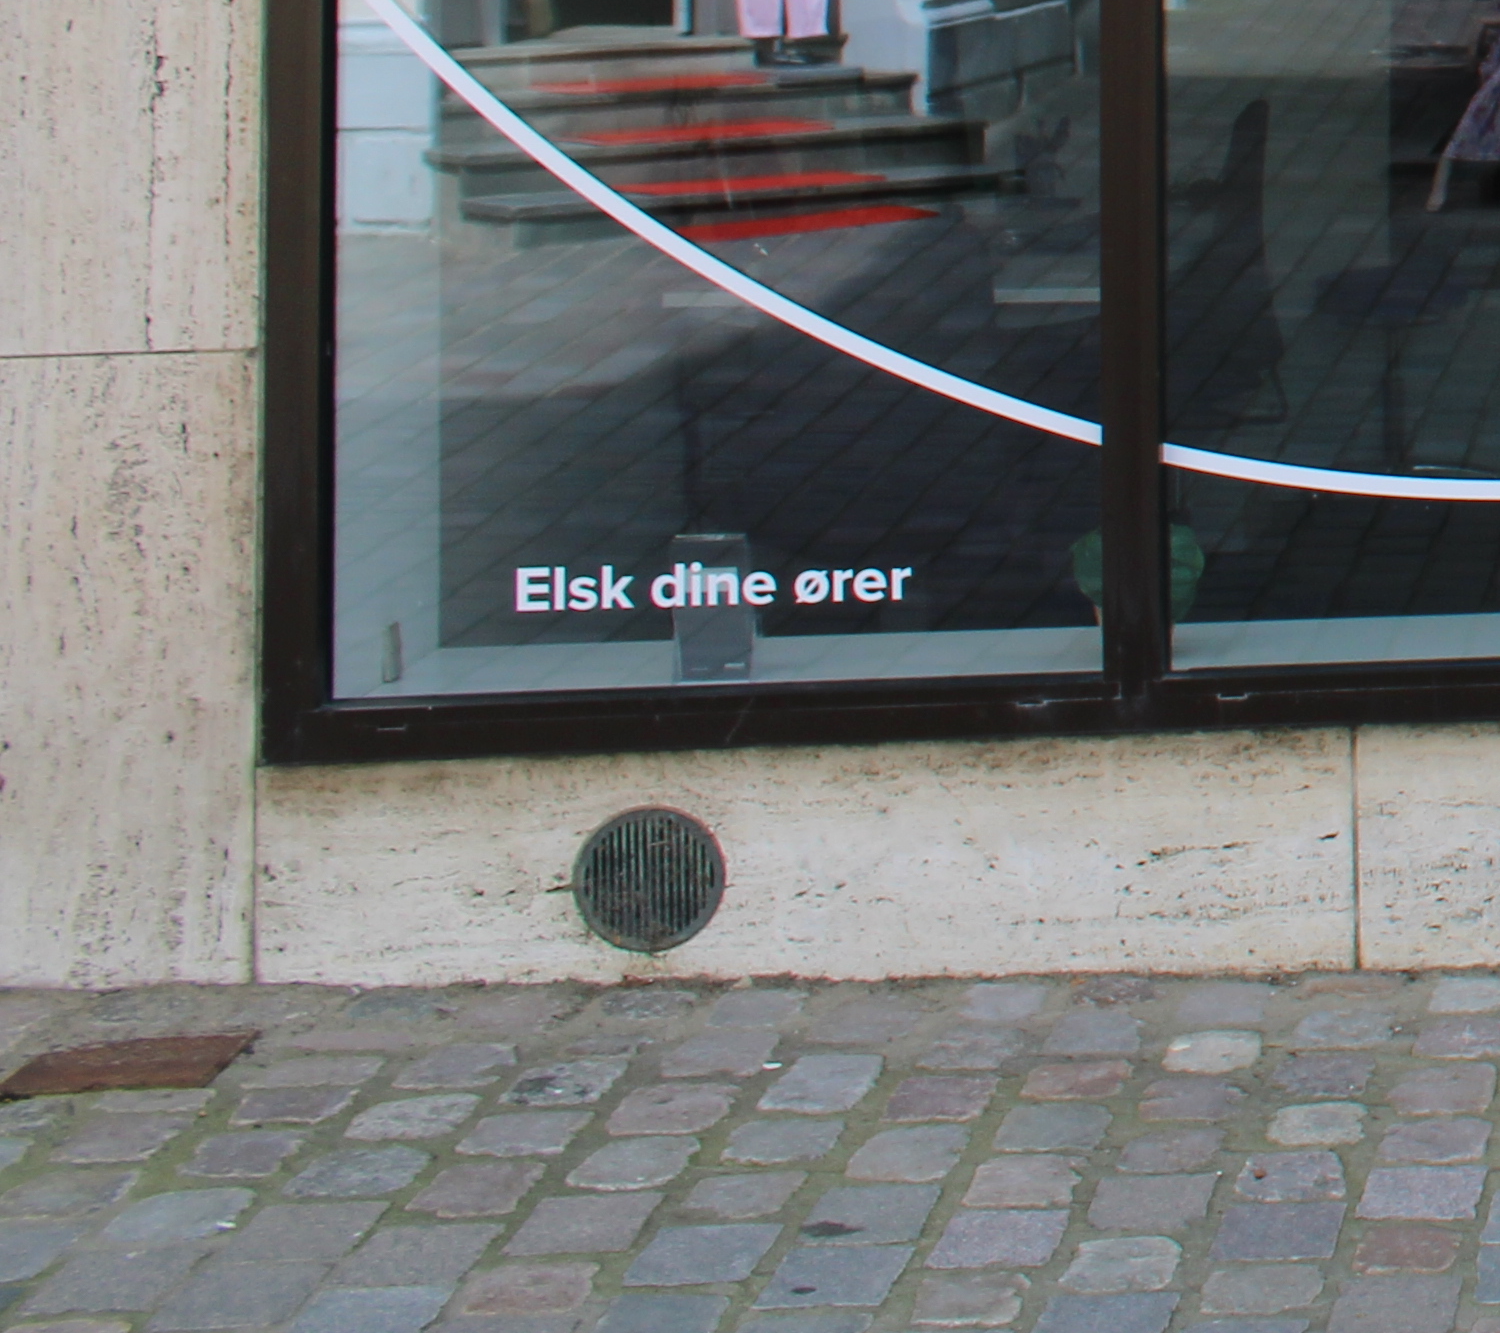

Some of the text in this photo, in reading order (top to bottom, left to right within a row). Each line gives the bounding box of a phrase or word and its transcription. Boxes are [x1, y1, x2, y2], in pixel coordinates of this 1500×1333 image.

[514, 560, 913, 614] Elsk dine ører
